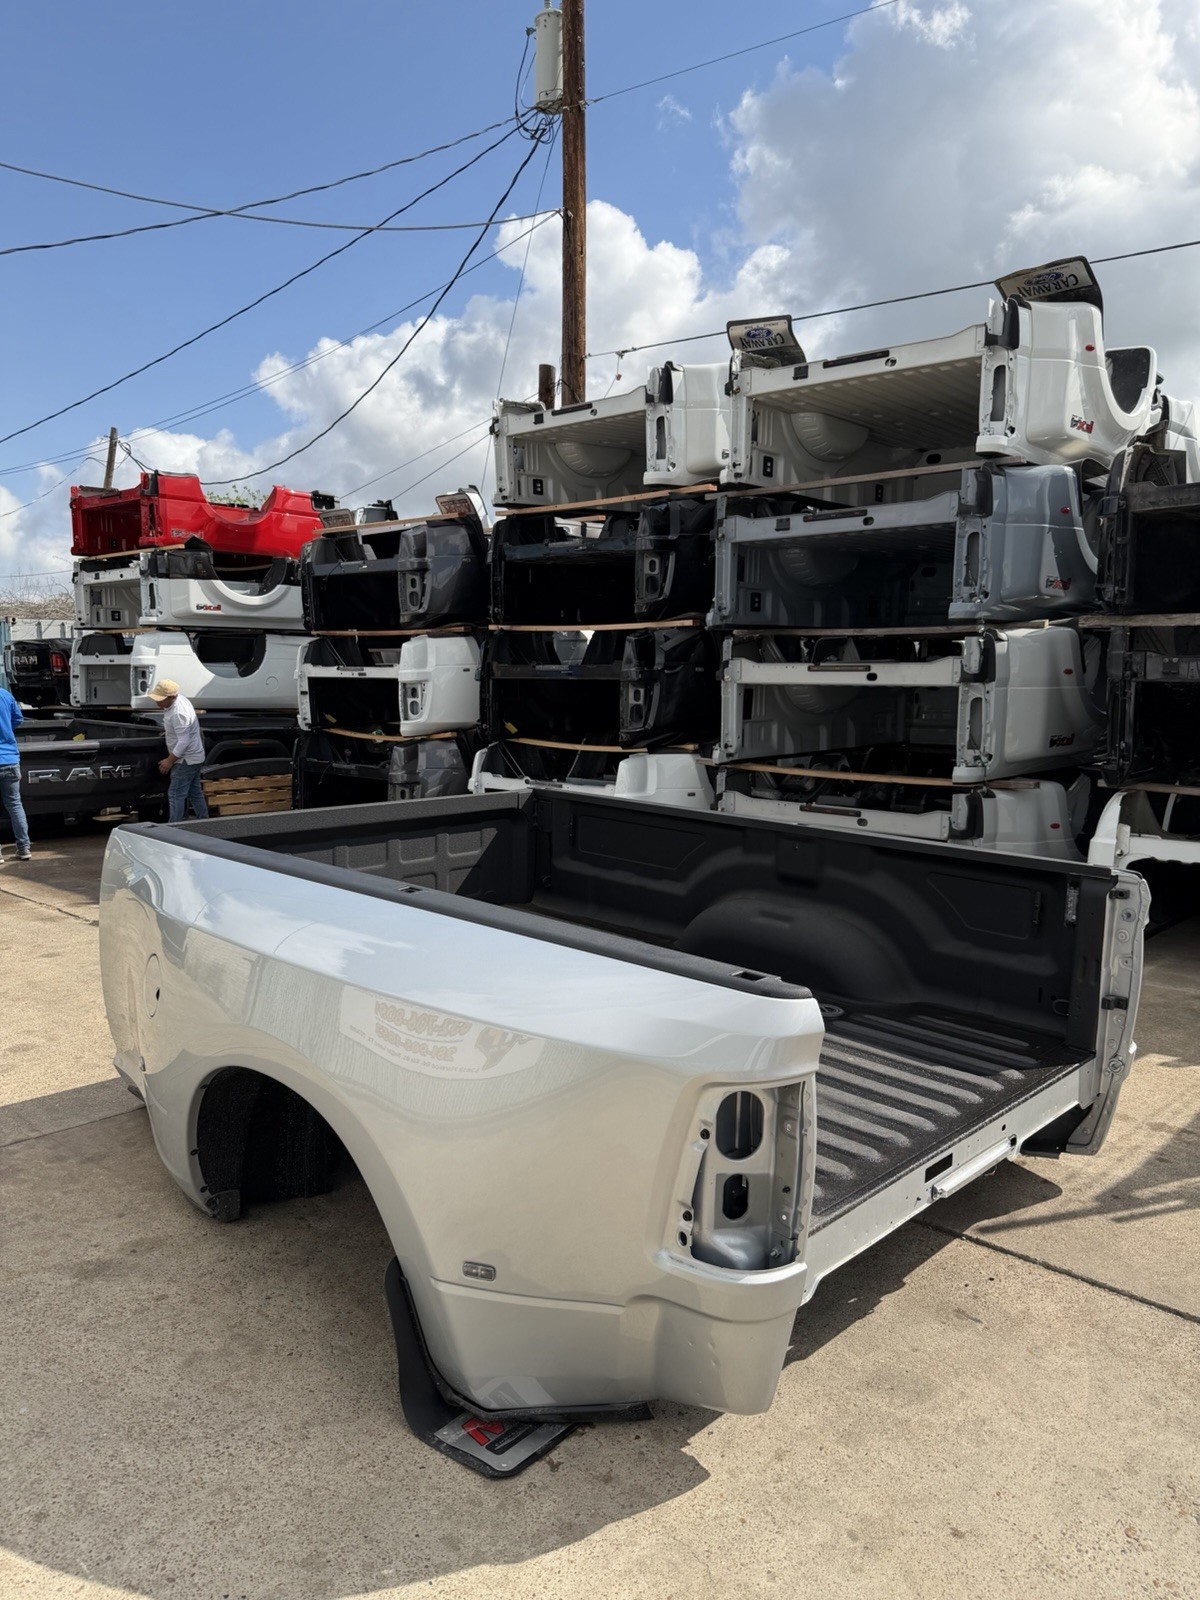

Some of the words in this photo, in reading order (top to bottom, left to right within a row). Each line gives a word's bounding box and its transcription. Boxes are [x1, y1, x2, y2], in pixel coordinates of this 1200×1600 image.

[1016, 273, 1079, 298] CARAWAY
[739, 332, 785, 350] CARAWAY
[12, 655, 38, 665] RAM
[28, 764, 132, 784] RAM
